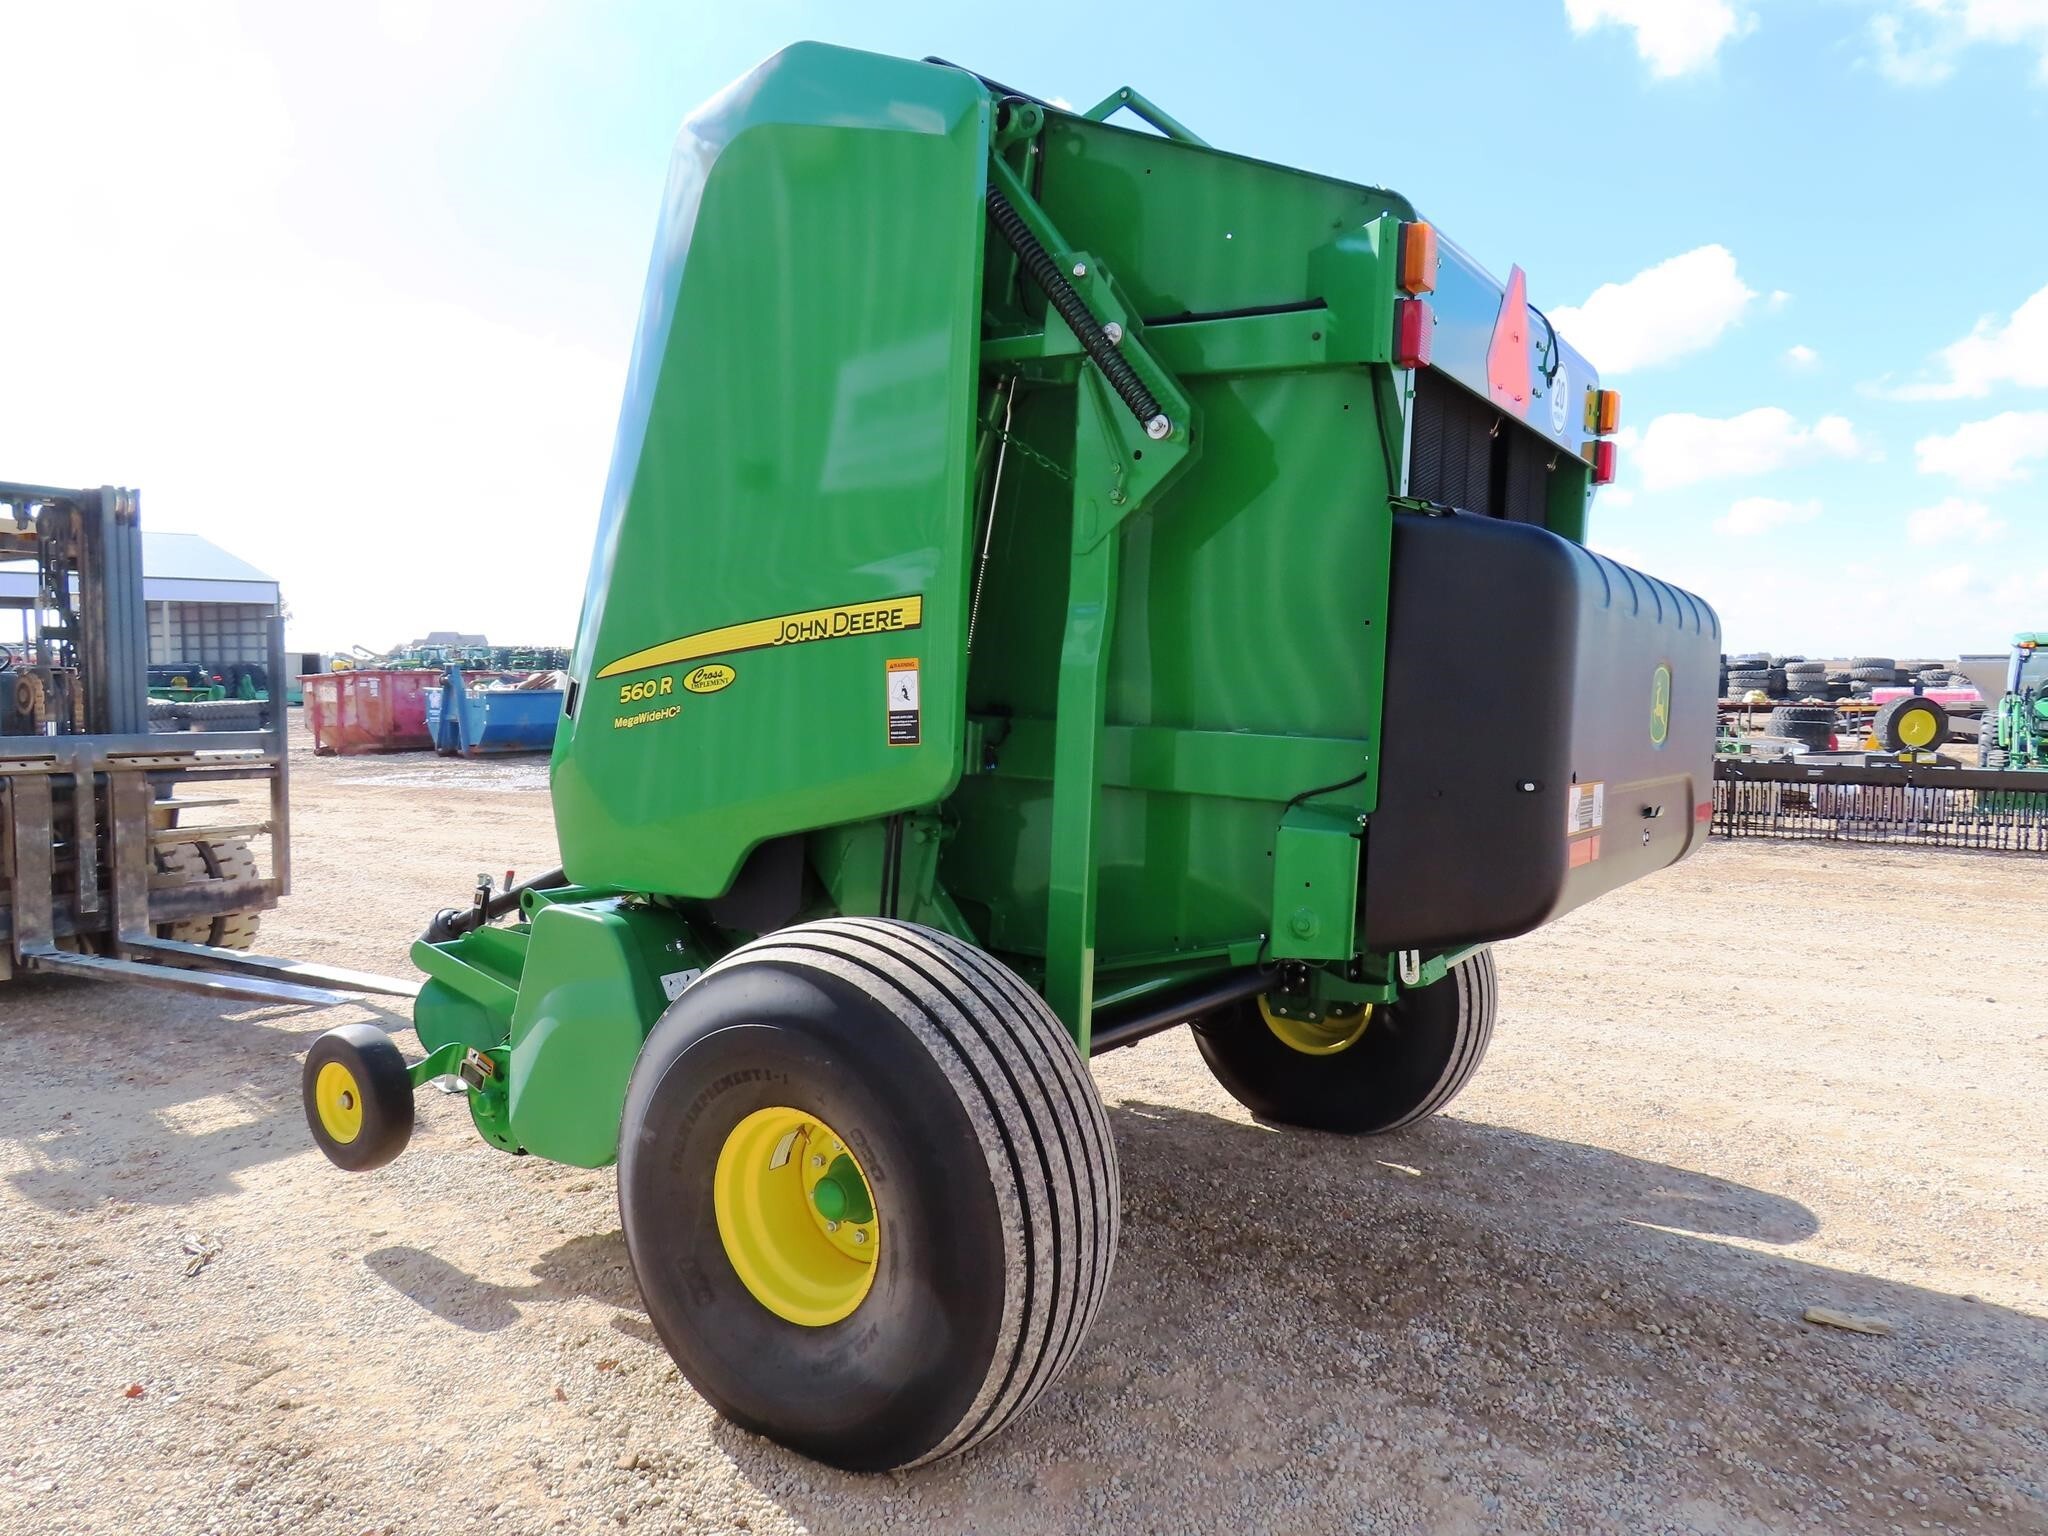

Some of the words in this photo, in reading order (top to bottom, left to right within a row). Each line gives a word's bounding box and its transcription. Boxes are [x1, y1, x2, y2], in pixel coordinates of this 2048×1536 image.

[774, 618, 828, 643] JOHN
[833, 608, 904, 634] DEERE
[690, 676, 730, 690] IMPLEMENT
[692, 668, 724, 684] Cross
[620, 679, 657, 704] 560
